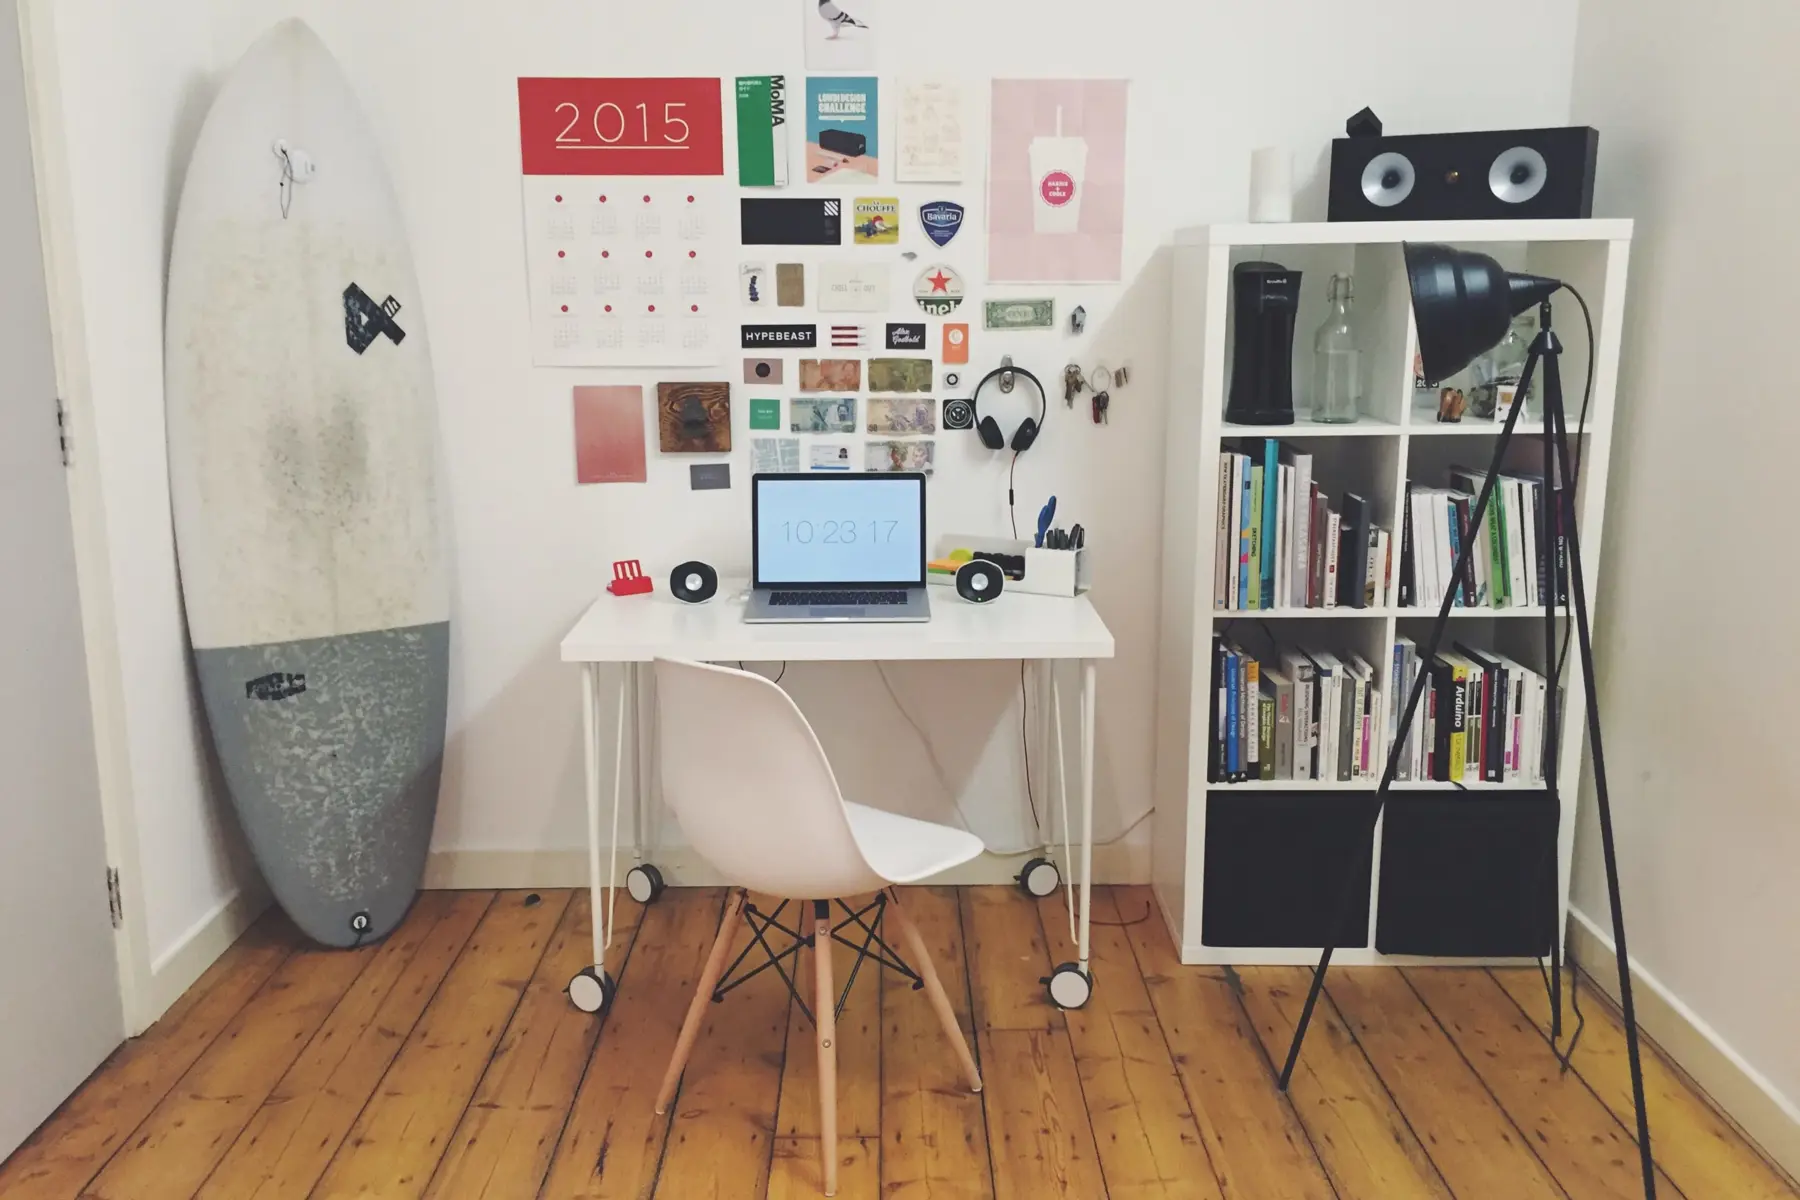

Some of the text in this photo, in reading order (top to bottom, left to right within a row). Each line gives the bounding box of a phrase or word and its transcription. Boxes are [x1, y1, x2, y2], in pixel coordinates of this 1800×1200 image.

[771, 76, 785, 127] MoMA
[818, 102, 867, 113] CHALLENGE
[554, 101, 690, 143] 2015
[856, 205, 897, 213] CHOUFFE
[745, 331, 812, 341] HYPEBEAST
[867, 520, 899, 543] 17
[1454, 686, 1465, 728] Arduino
